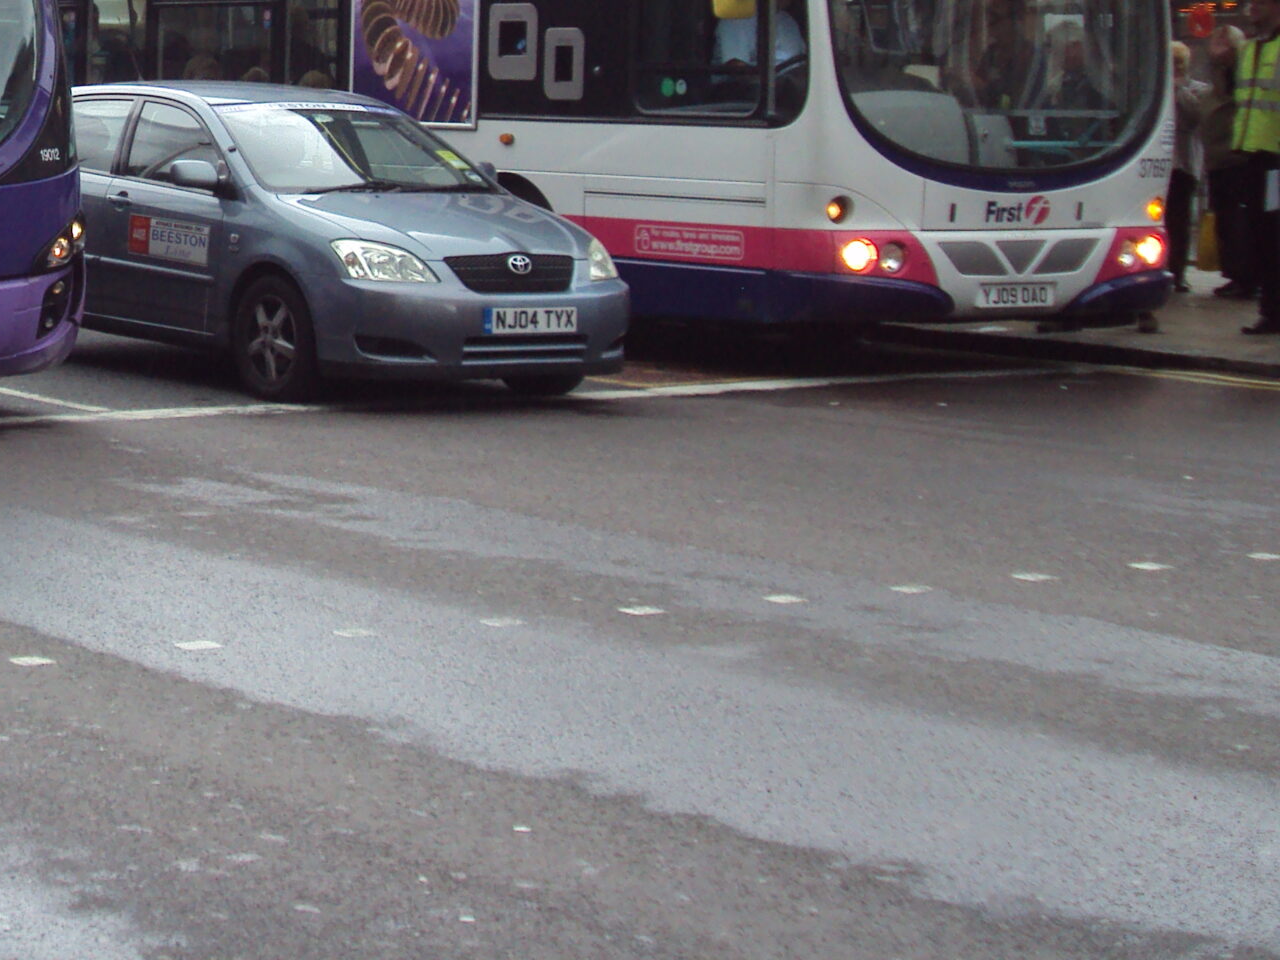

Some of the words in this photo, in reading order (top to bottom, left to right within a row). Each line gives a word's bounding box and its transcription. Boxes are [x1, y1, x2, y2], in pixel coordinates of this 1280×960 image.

[40, 149, 61, 161] 19012
[985, 201, 1023, 223] First
[151, 229, 207, 249] BEESTON
[651, 240, 740, 256] www.firstgroup.com
[982, 287, 1018, 304] YJ09
[495, 310, 539, 329] NJ04
[544, 309, 574, 329] TYX
